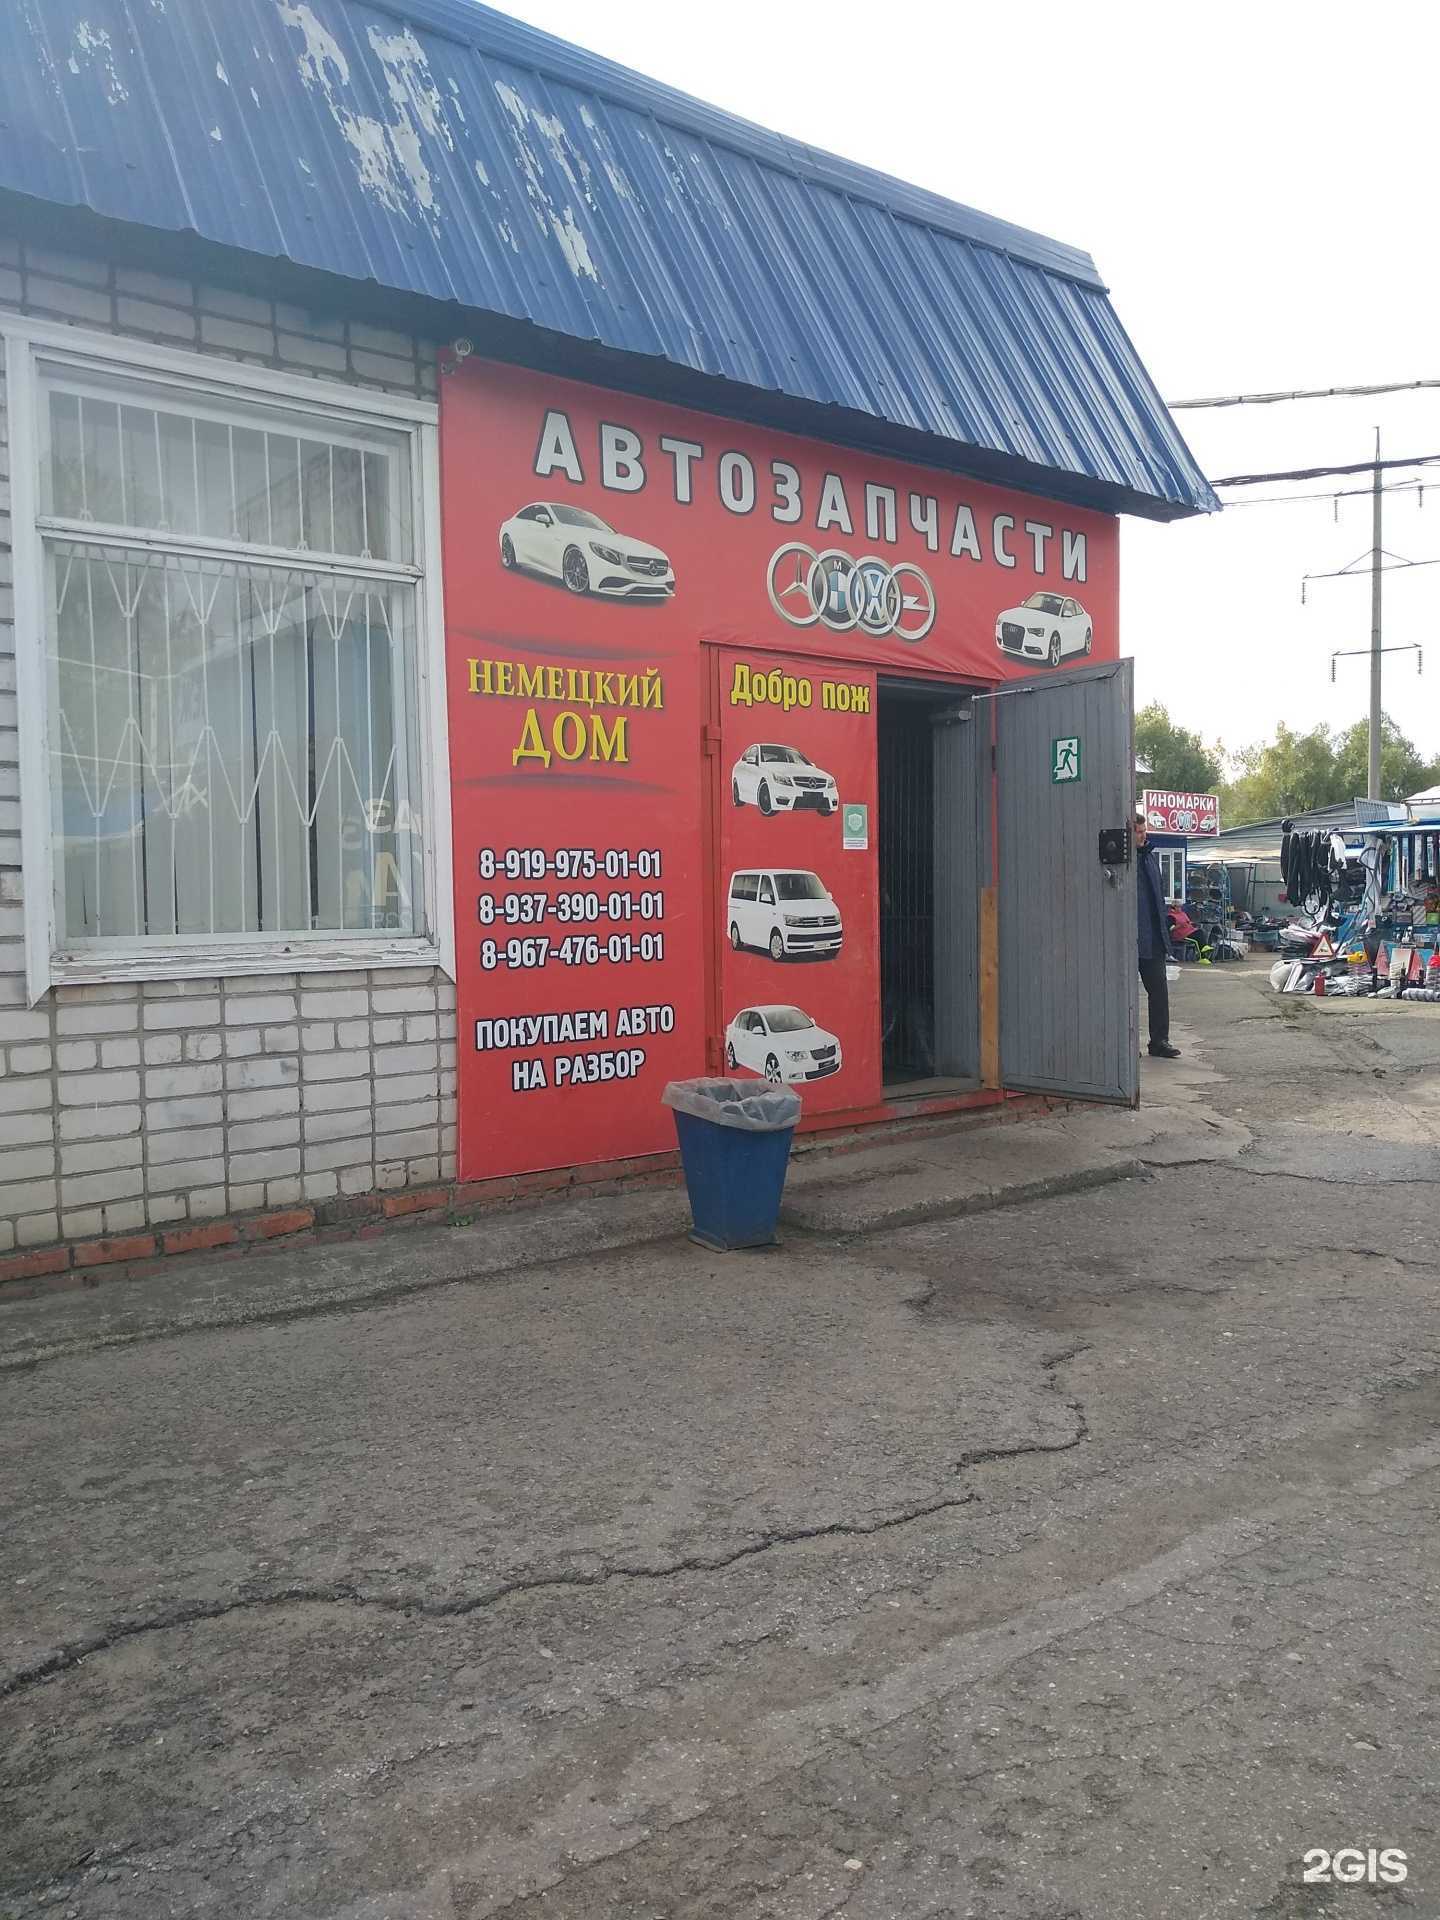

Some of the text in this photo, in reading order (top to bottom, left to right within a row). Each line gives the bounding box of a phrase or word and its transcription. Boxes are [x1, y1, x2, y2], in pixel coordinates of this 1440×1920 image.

[533, 409, 1088, 583] АВТОЗАПЧАСТИ
[466, 657, 664, 709] НЕМЕЦКИЙ
[730, 663, 871, 713] Добро пож
[512, 708, 630, 769] ДОМ
[1149, 792, 1214, 811] ИНОМАРКИ
[479, 848, 662, 879] 8-919-975-01-01
[479, 891, 664, 924] 8-937-390-01-01
[480, 933, 664, 970] 8-967-476-01-01
[475, 1004, 675, 1050] ПОКУПАЕМ АВТО
[512, 1048, 646, 1091] НА РАЗБОР
